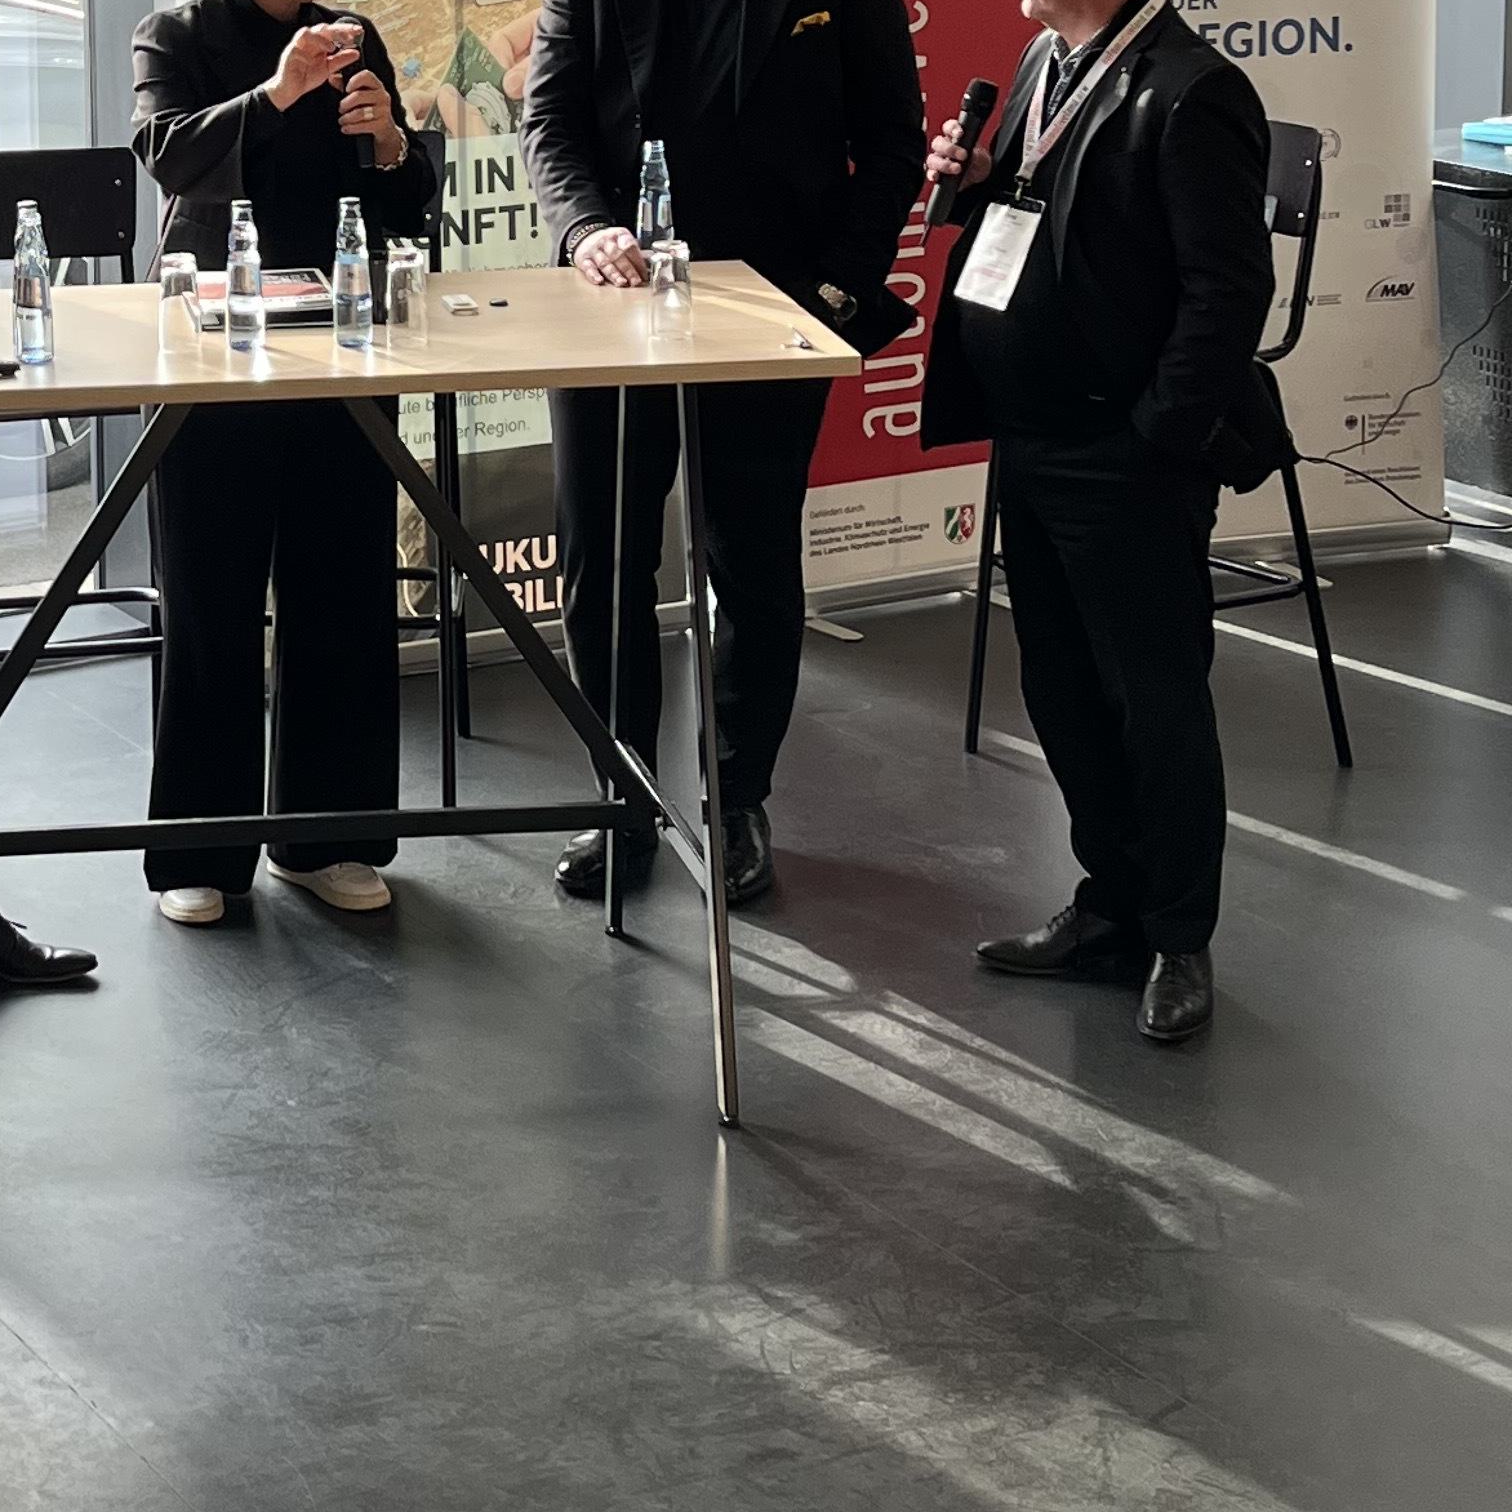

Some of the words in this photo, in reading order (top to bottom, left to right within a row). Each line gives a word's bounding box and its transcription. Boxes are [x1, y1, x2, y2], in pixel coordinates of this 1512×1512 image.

[1198, 16, 1354, 59] EGION.
[475, 156, 515, 195] IN
[475, 418, 530, 438] Region.
